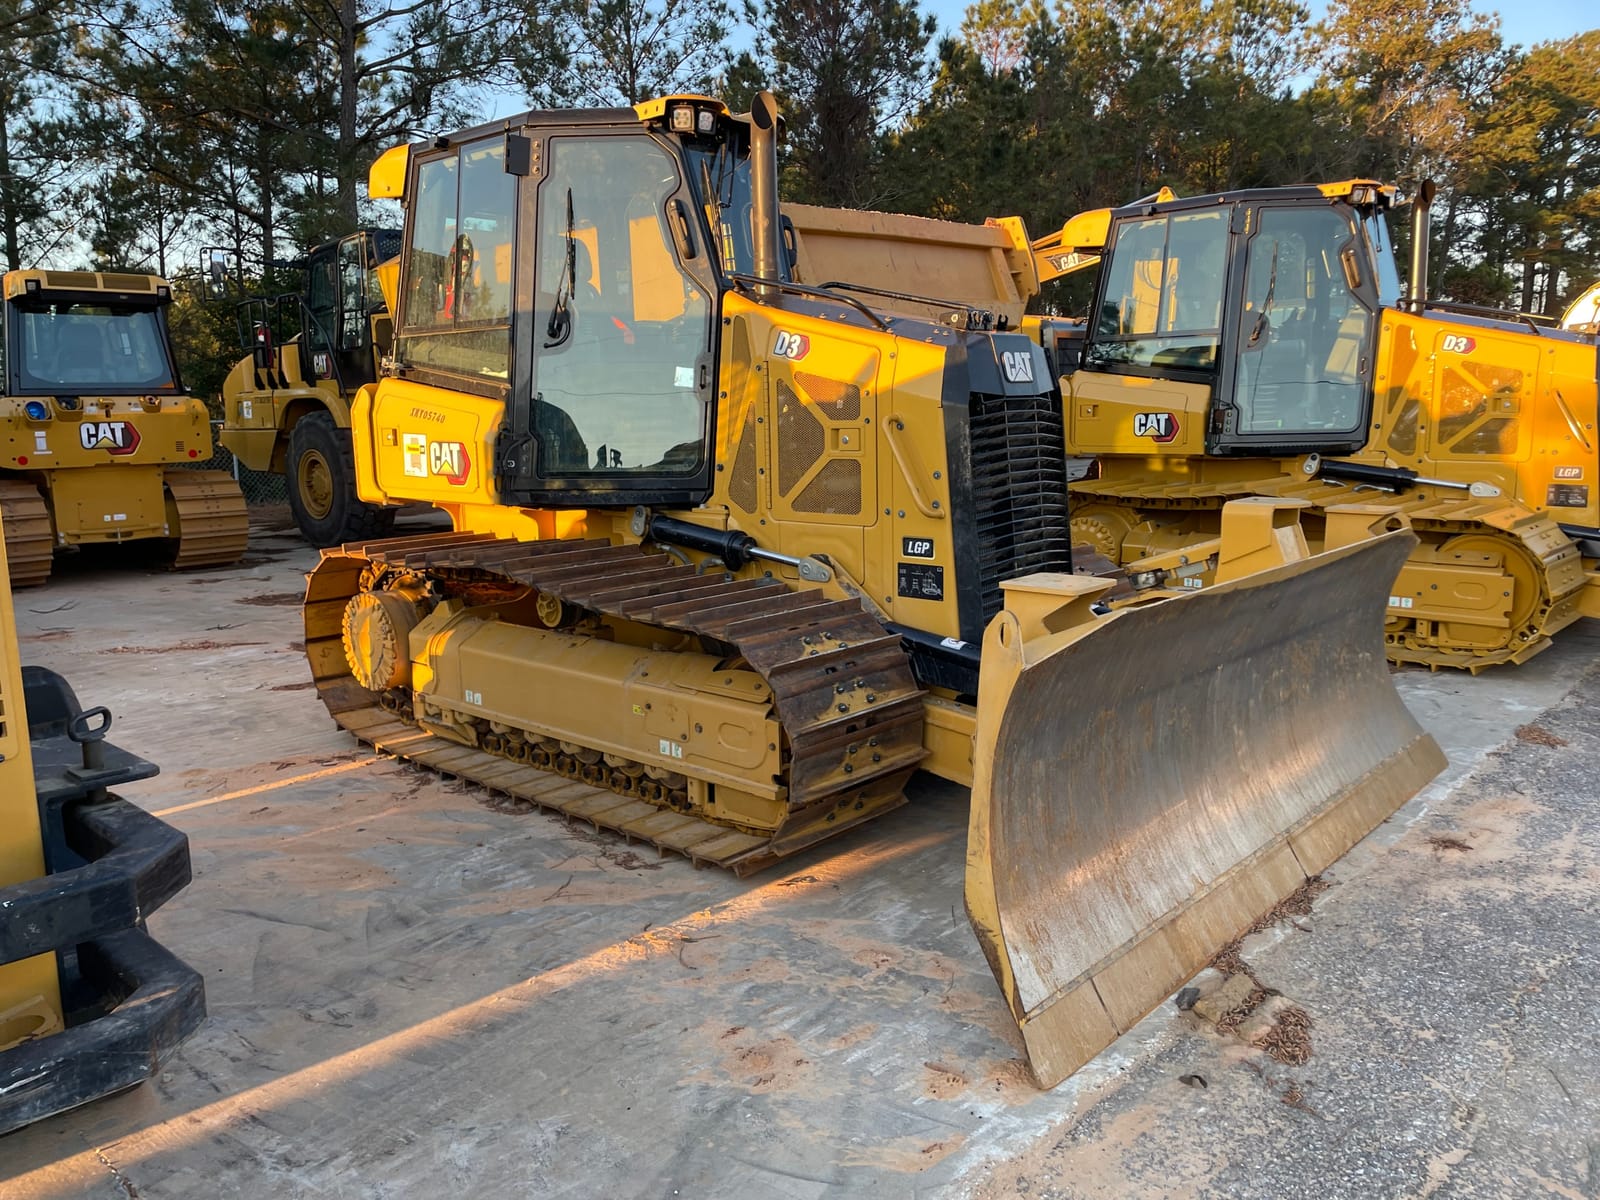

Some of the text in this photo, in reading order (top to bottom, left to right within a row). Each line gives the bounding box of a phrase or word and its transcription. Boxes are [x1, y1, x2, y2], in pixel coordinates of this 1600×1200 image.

[1060, 252, 1079, 270] CAT
[774, 331, 801, 358] D3
[1443, 335, 1467, 352] D3
[313, 354, 327, 375] CAT
[1002, 351, 1034, 381] CAT
[80, 422, 125, 449] CAT
[1134, 413, 1169, 436] CAT
[430, 441, 461, 476] CAT
[907, 541, 930, 554] LGP
